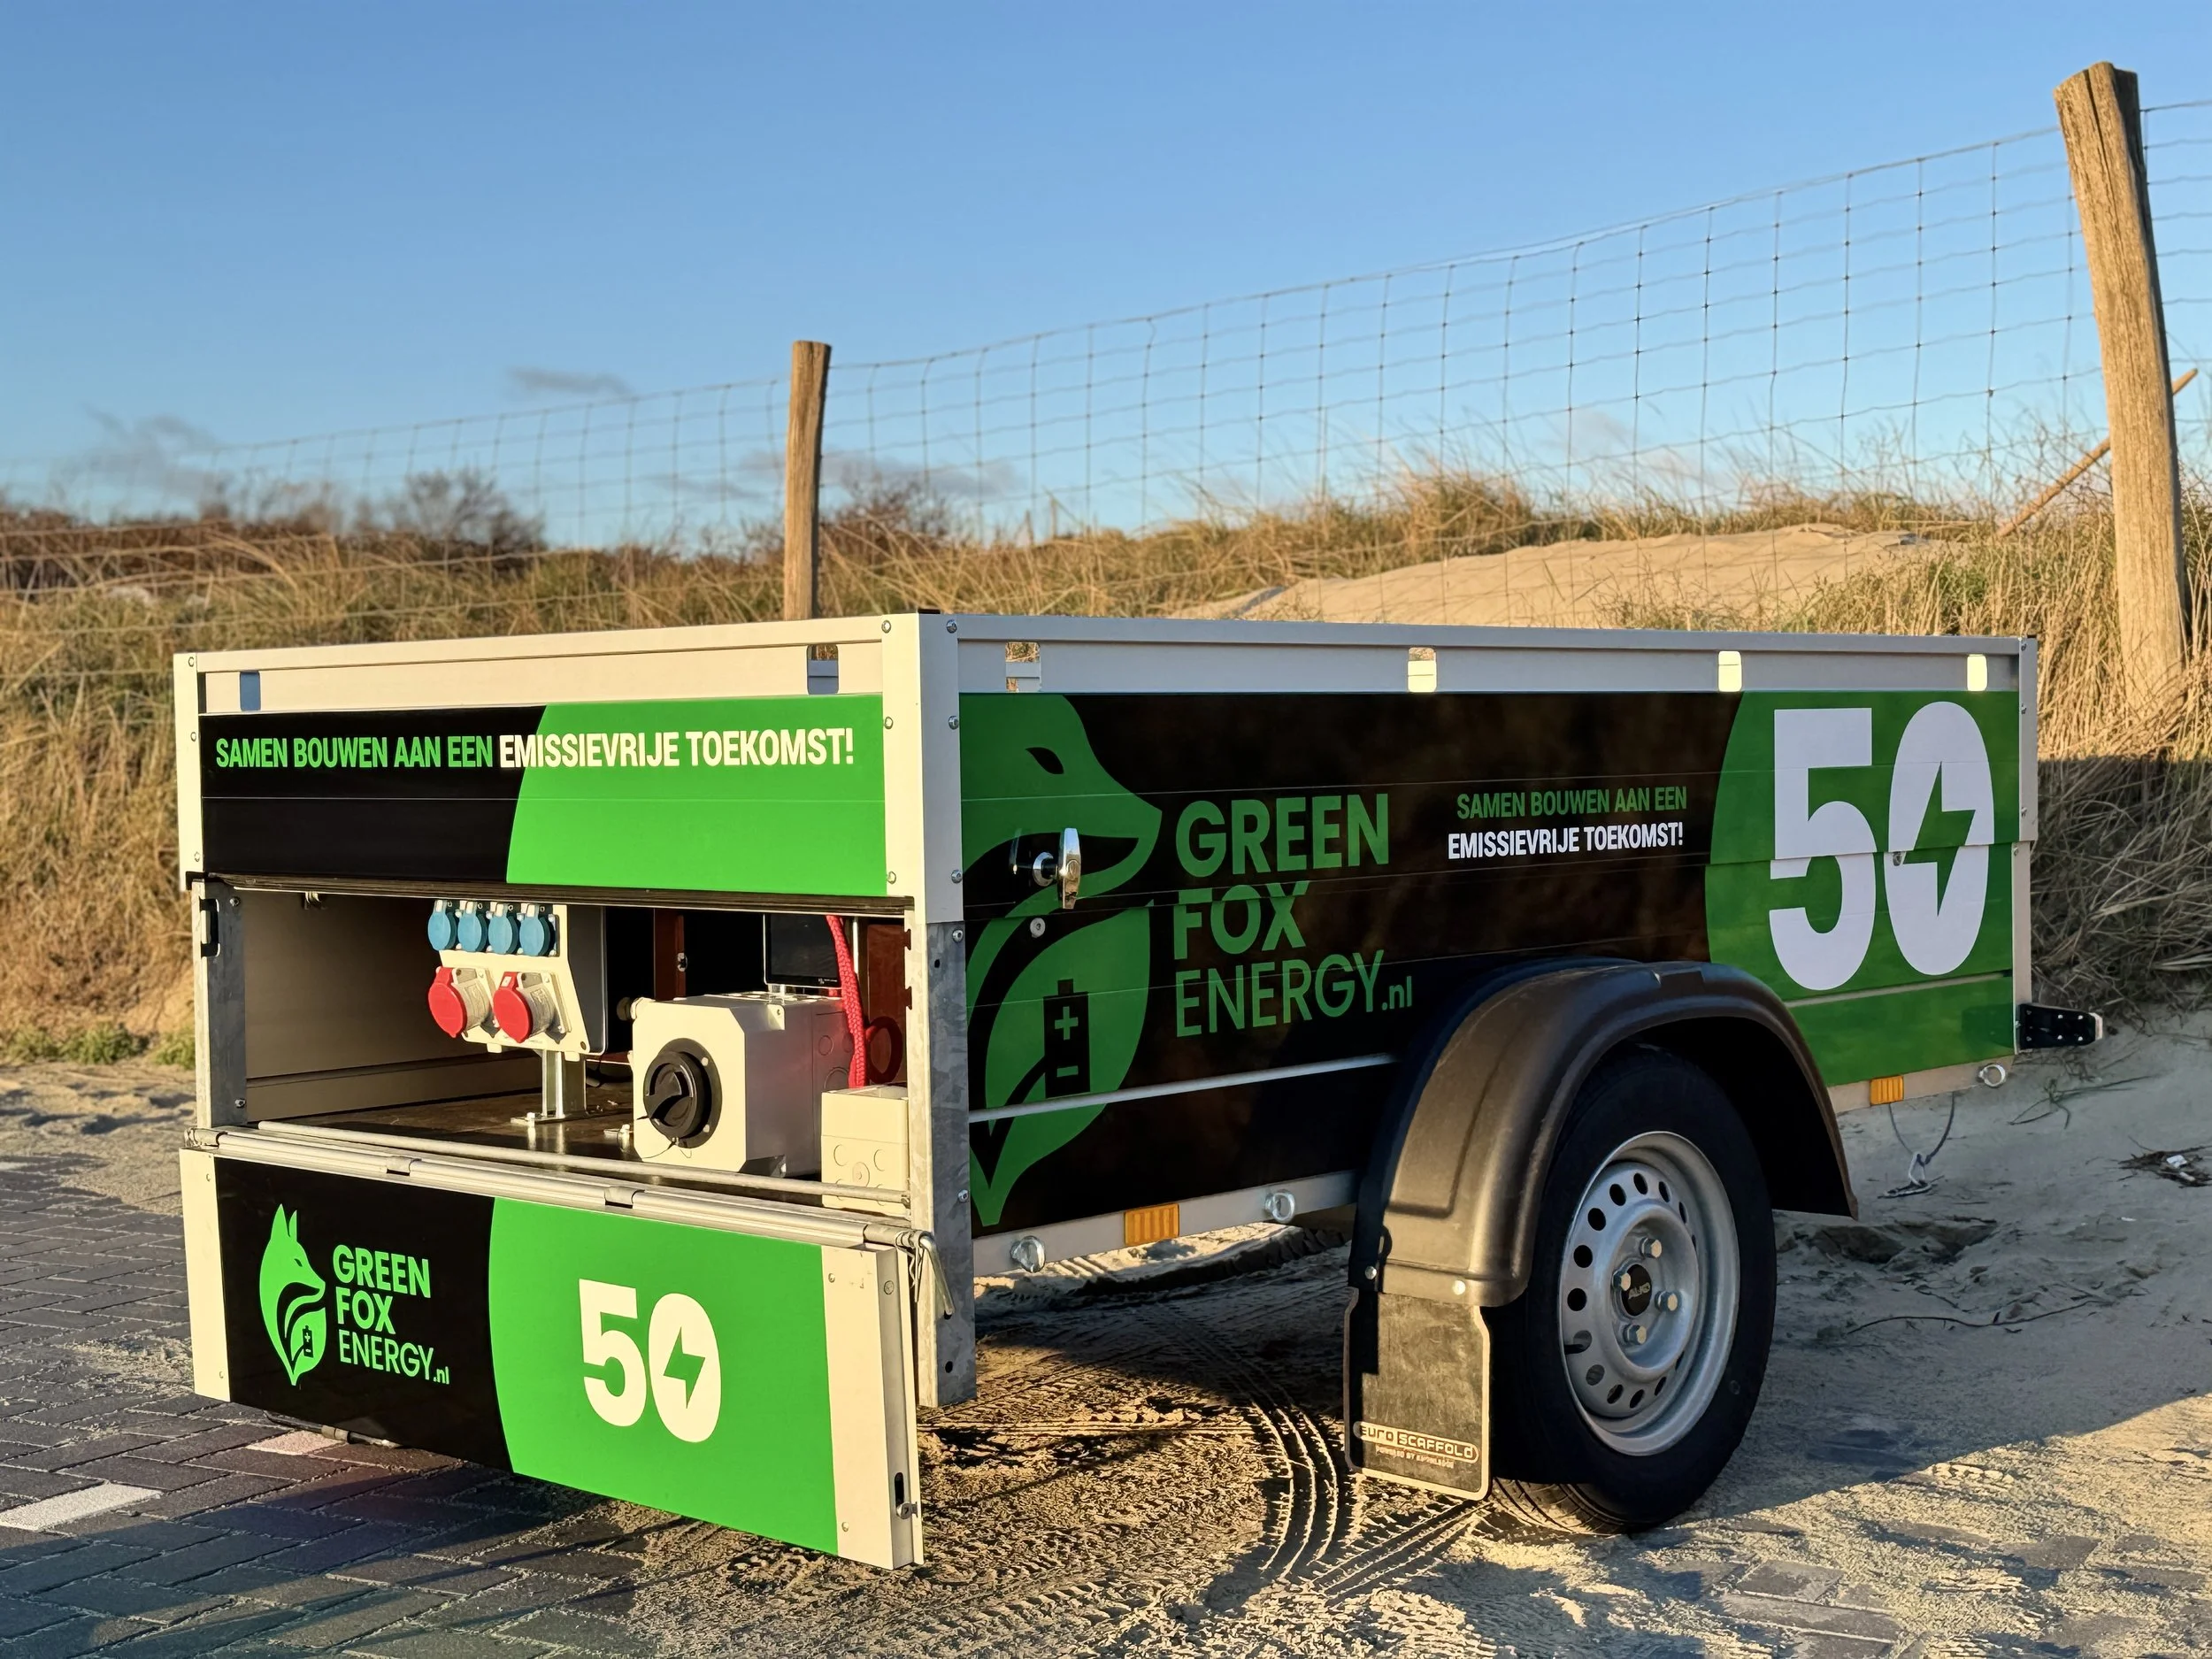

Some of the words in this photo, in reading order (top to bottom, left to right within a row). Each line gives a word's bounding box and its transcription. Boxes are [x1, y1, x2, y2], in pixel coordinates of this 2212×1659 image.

[216, 737, 288, 768] SAMEN
[293, 736, 388, 768] BOUWEN
[394, 736, 442, 768] AAN
[447, 735, 494, 768] EEN
[499, 732, 680, 768] EMISSIEVRIJE
[686, 728, 854, 767] TOEKOMST!
[1456, 792, 1525, 819] SAMEN
[1530, 789, 1610, 817] BOUWEN
[1614, 787, 1650, 813] AAN
[1655, 786, 1687, 811] EEN
[1175, 793, 1389, 878] GREEN
[1448, 826, 1580, 860] EMISSIEVRIJE
[1583, 821, 1684, 852] TOEKOMST!
[1770, 701, 1995, 991] 50
[1173, 880, 1313, 960] FOX
[1173, 949, 1412, 1038] ENERGY.nl
[332, 1244, 432, 1299] GREEN
[335, 1286, 396, 1335] FOX
[338, 1328, 450, 1385] ENERGY.nl
[578, 1278, 722, 1443] 50
